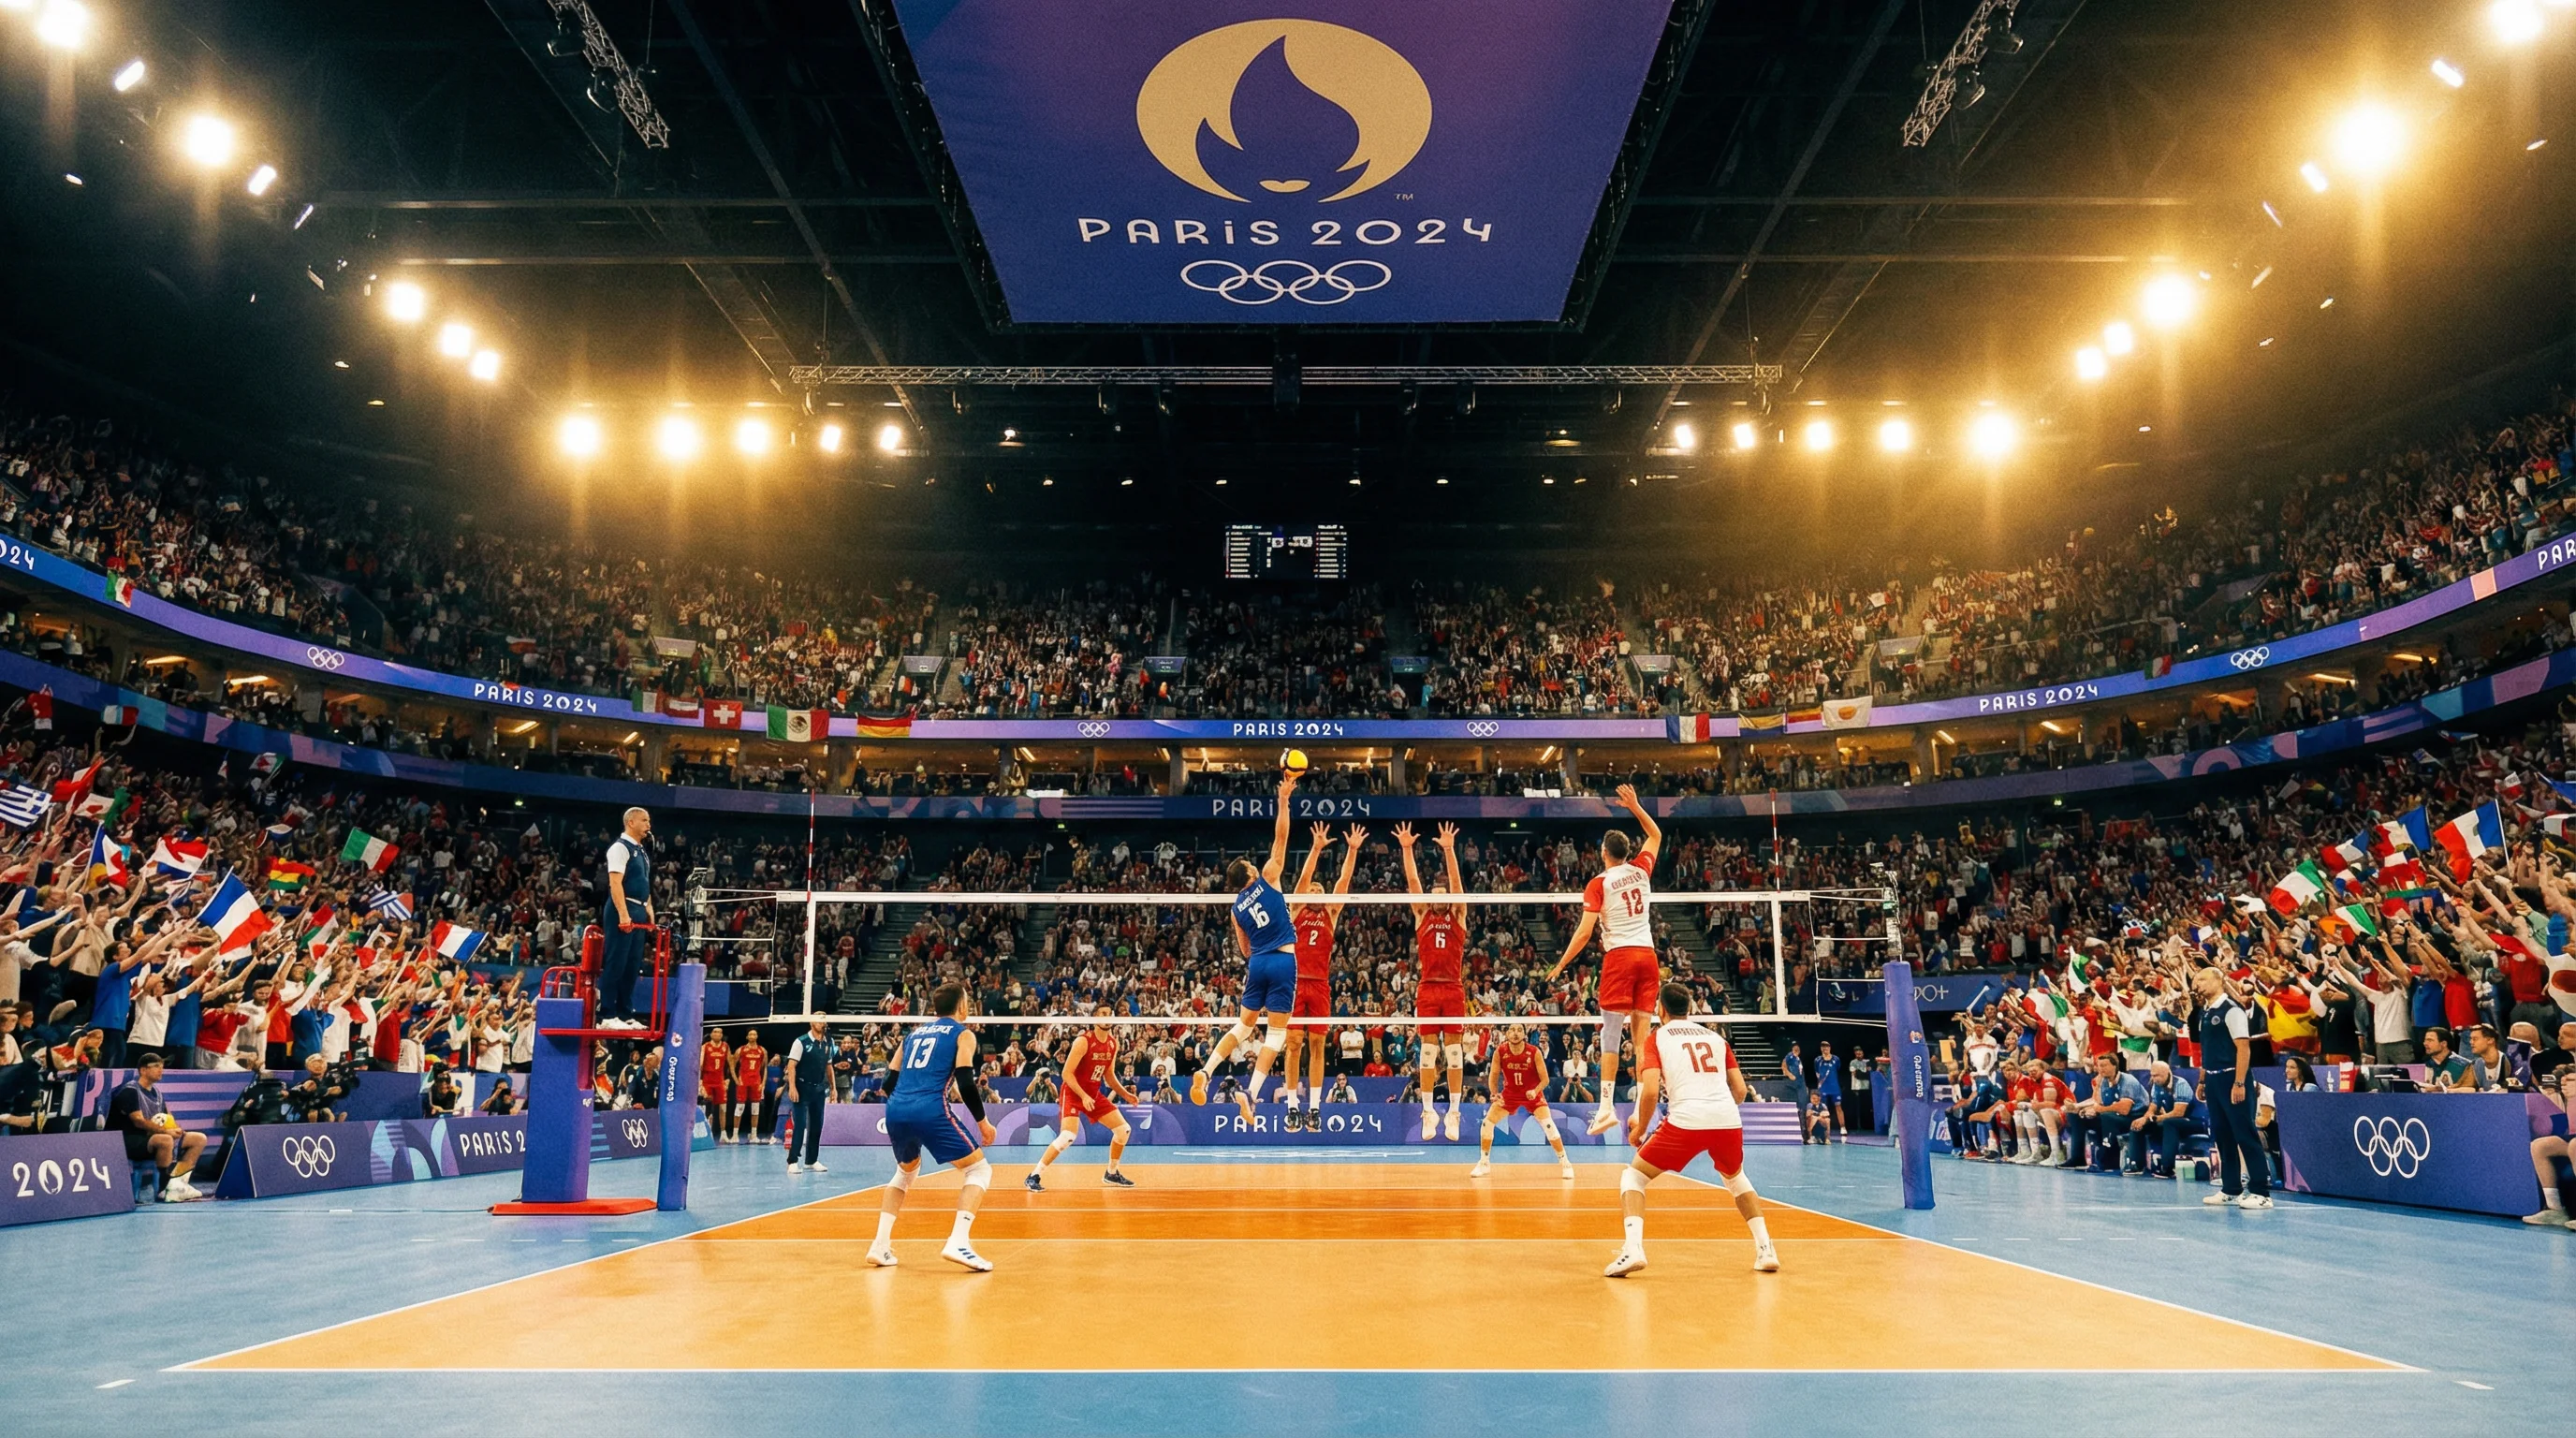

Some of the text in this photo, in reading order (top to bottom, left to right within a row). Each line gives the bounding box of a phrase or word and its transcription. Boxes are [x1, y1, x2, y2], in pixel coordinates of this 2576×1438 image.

[1310, 217, 1492, 245] 2024
[474, 682, 597, 713] PARIS 2024
[1979, 683, 2098, 712] PARIS 2024
[1234, 723, 1343, 736] PARIS 2024
[1212, 799, 1370, 816] PARi 2024
[1248, 902, 1270, 929] 16
[1309, 930, 1319, 946] 2
[906, 1037, 937, 1069] 13
[1682, 1042, 1719, 1073] 12
[12, 1157, 111, 1197] 2024
